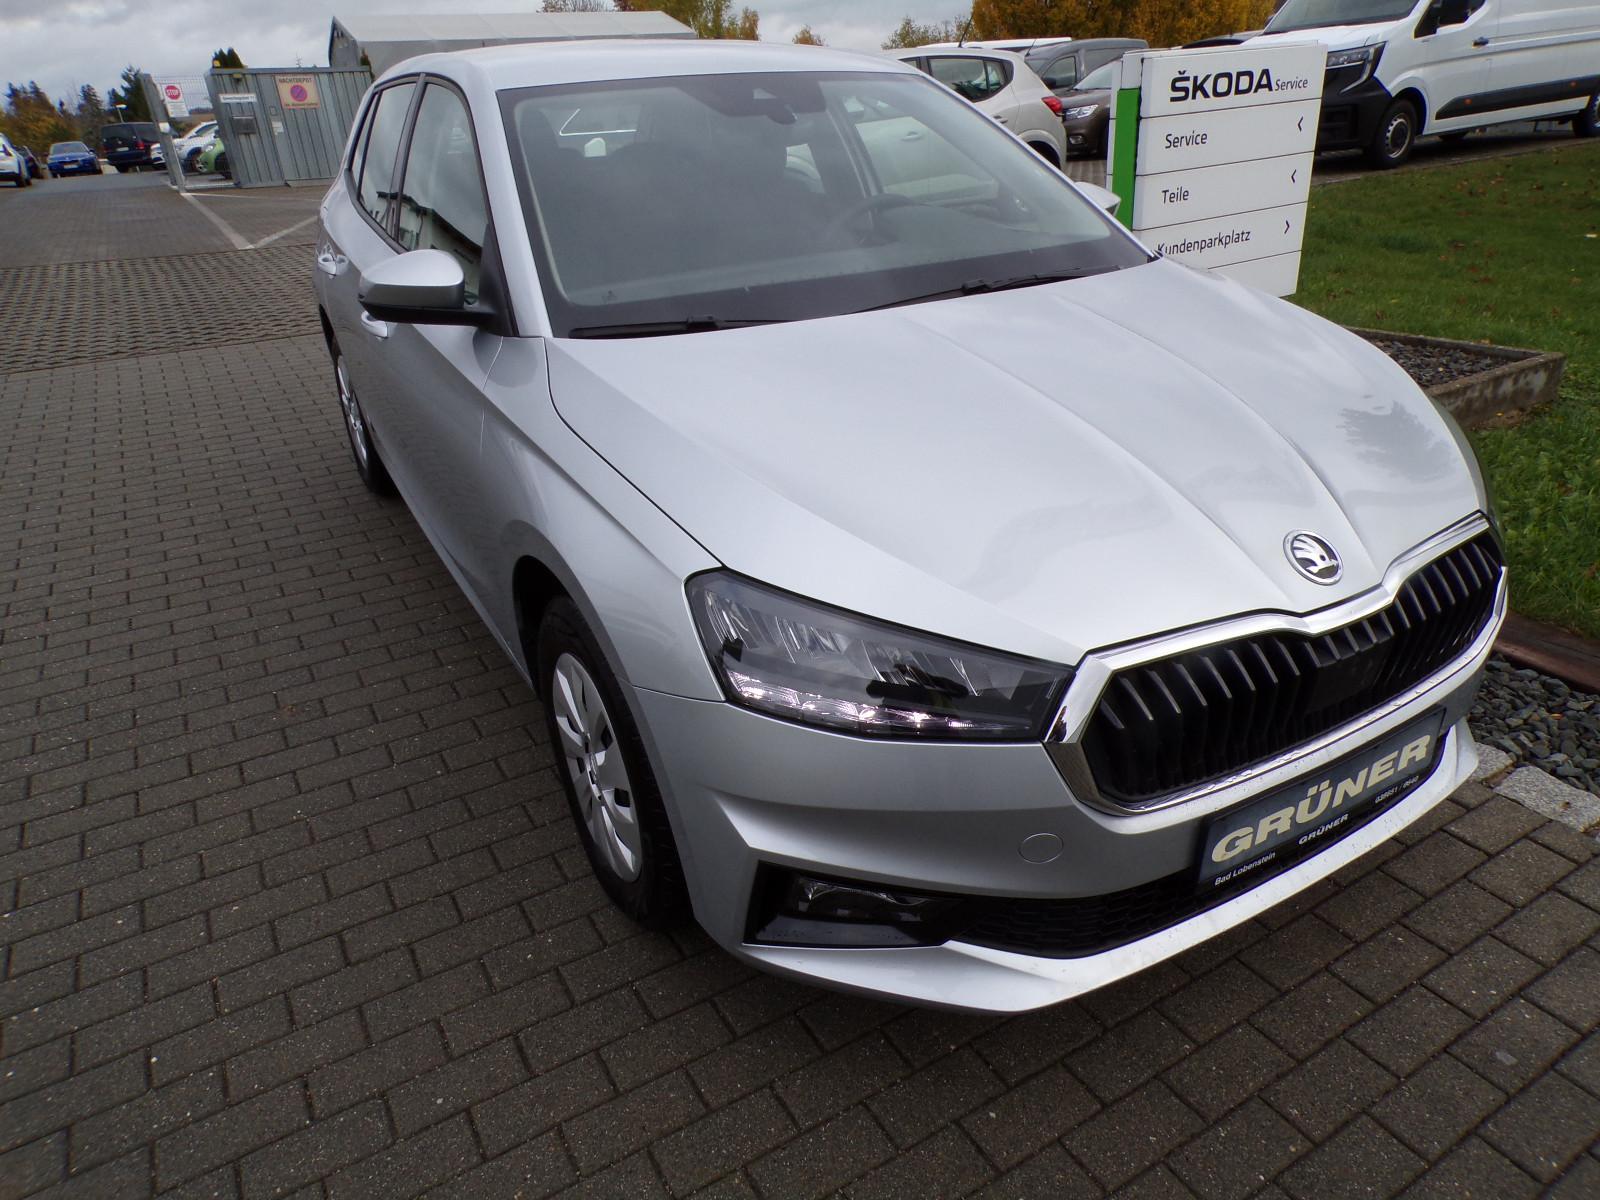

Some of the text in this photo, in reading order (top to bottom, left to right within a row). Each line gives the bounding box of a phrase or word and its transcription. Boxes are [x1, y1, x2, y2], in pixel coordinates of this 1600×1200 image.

[1169, 69, 1308, 102] ŠKODA Service
[1165, 130, 1208, 149] Service
[1161, 186, 1190, 204] Teile
[1157, 230, 1251, 256] Kundenparkplatz
[1211, 734, 1431, 863] GRÜNER
[1298, 813, 1349, 845] GRÜNER
[1214, 851, 1276, 886] Bad Lobenstein
